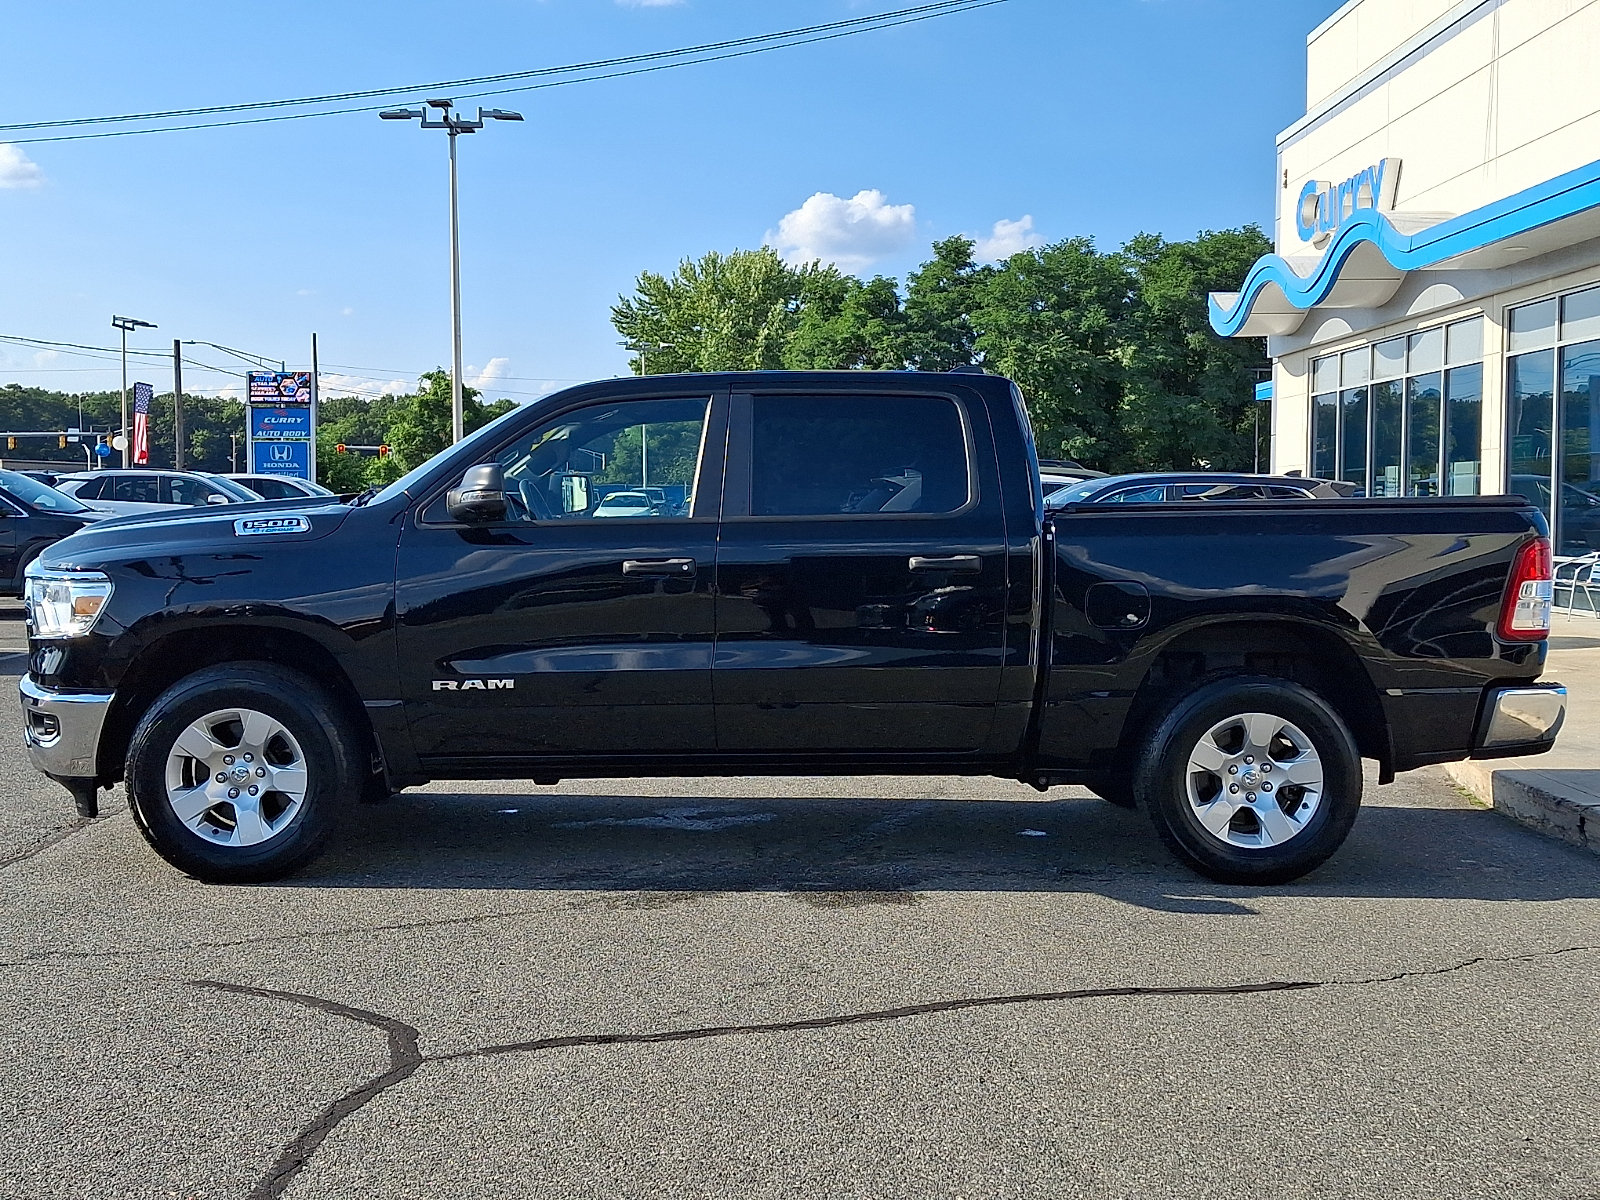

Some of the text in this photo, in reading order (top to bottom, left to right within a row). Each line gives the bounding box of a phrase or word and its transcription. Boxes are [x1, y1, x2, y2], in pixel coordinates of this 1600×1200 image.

[1296, 157, 1402, 243] Curry
[263, 416, 305, 424] CURRY
[245, 519, 298, 529] 1500
[431, 678, 516, 691] RAM
